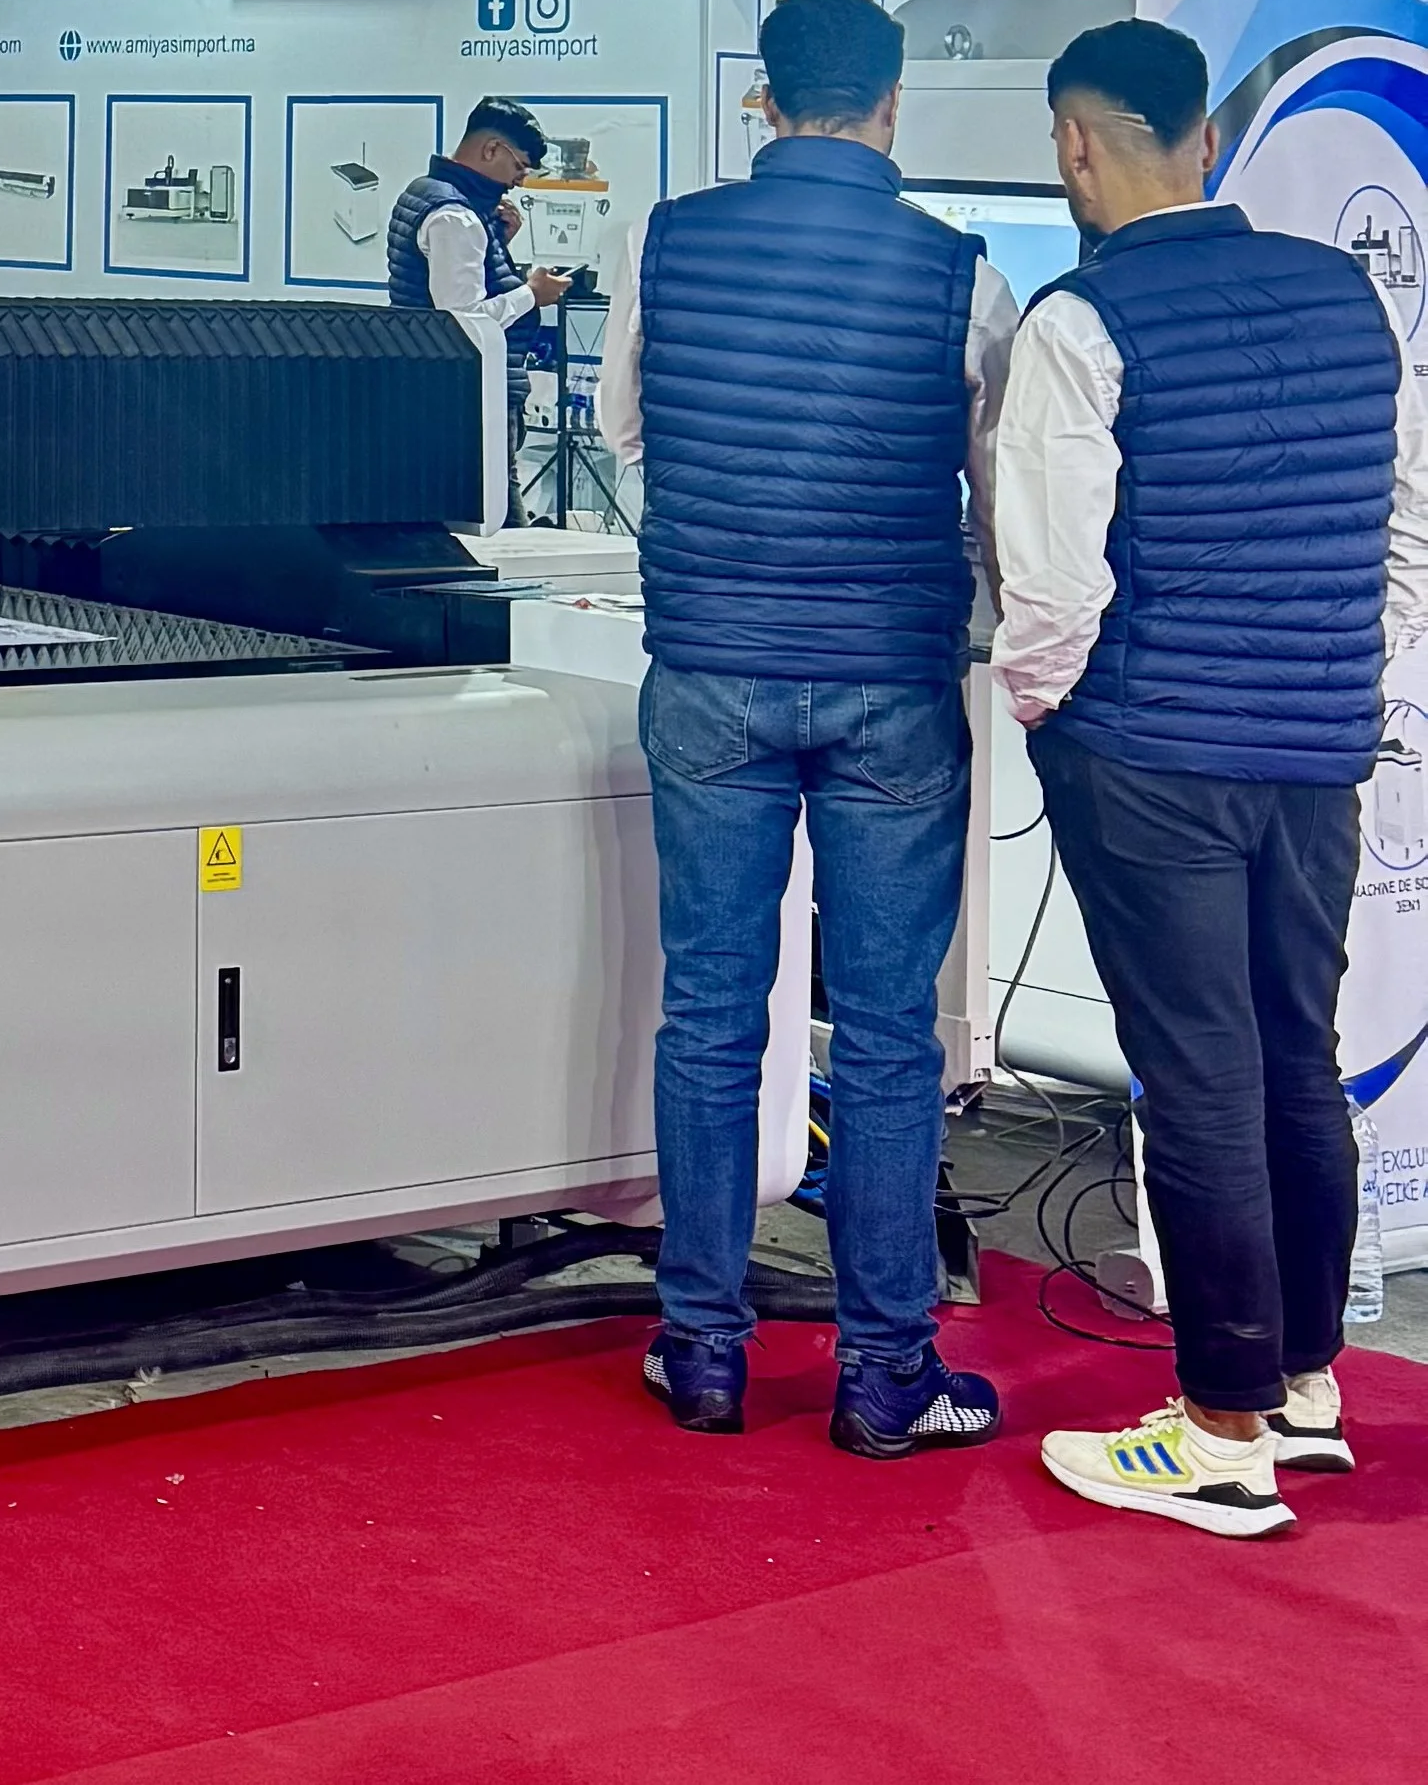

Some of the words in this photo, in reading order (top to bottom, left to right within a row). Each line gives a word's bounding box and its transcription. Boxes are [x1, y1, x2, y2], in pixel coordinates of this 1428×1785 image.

[86, 34, 255, 58] www.amiyasimport.ma
[460, 33, 598, 63] amiyasimport
[1398, 878, 1412, 893] DE
[1382, 1146, 1428, 1173] EXCLU
